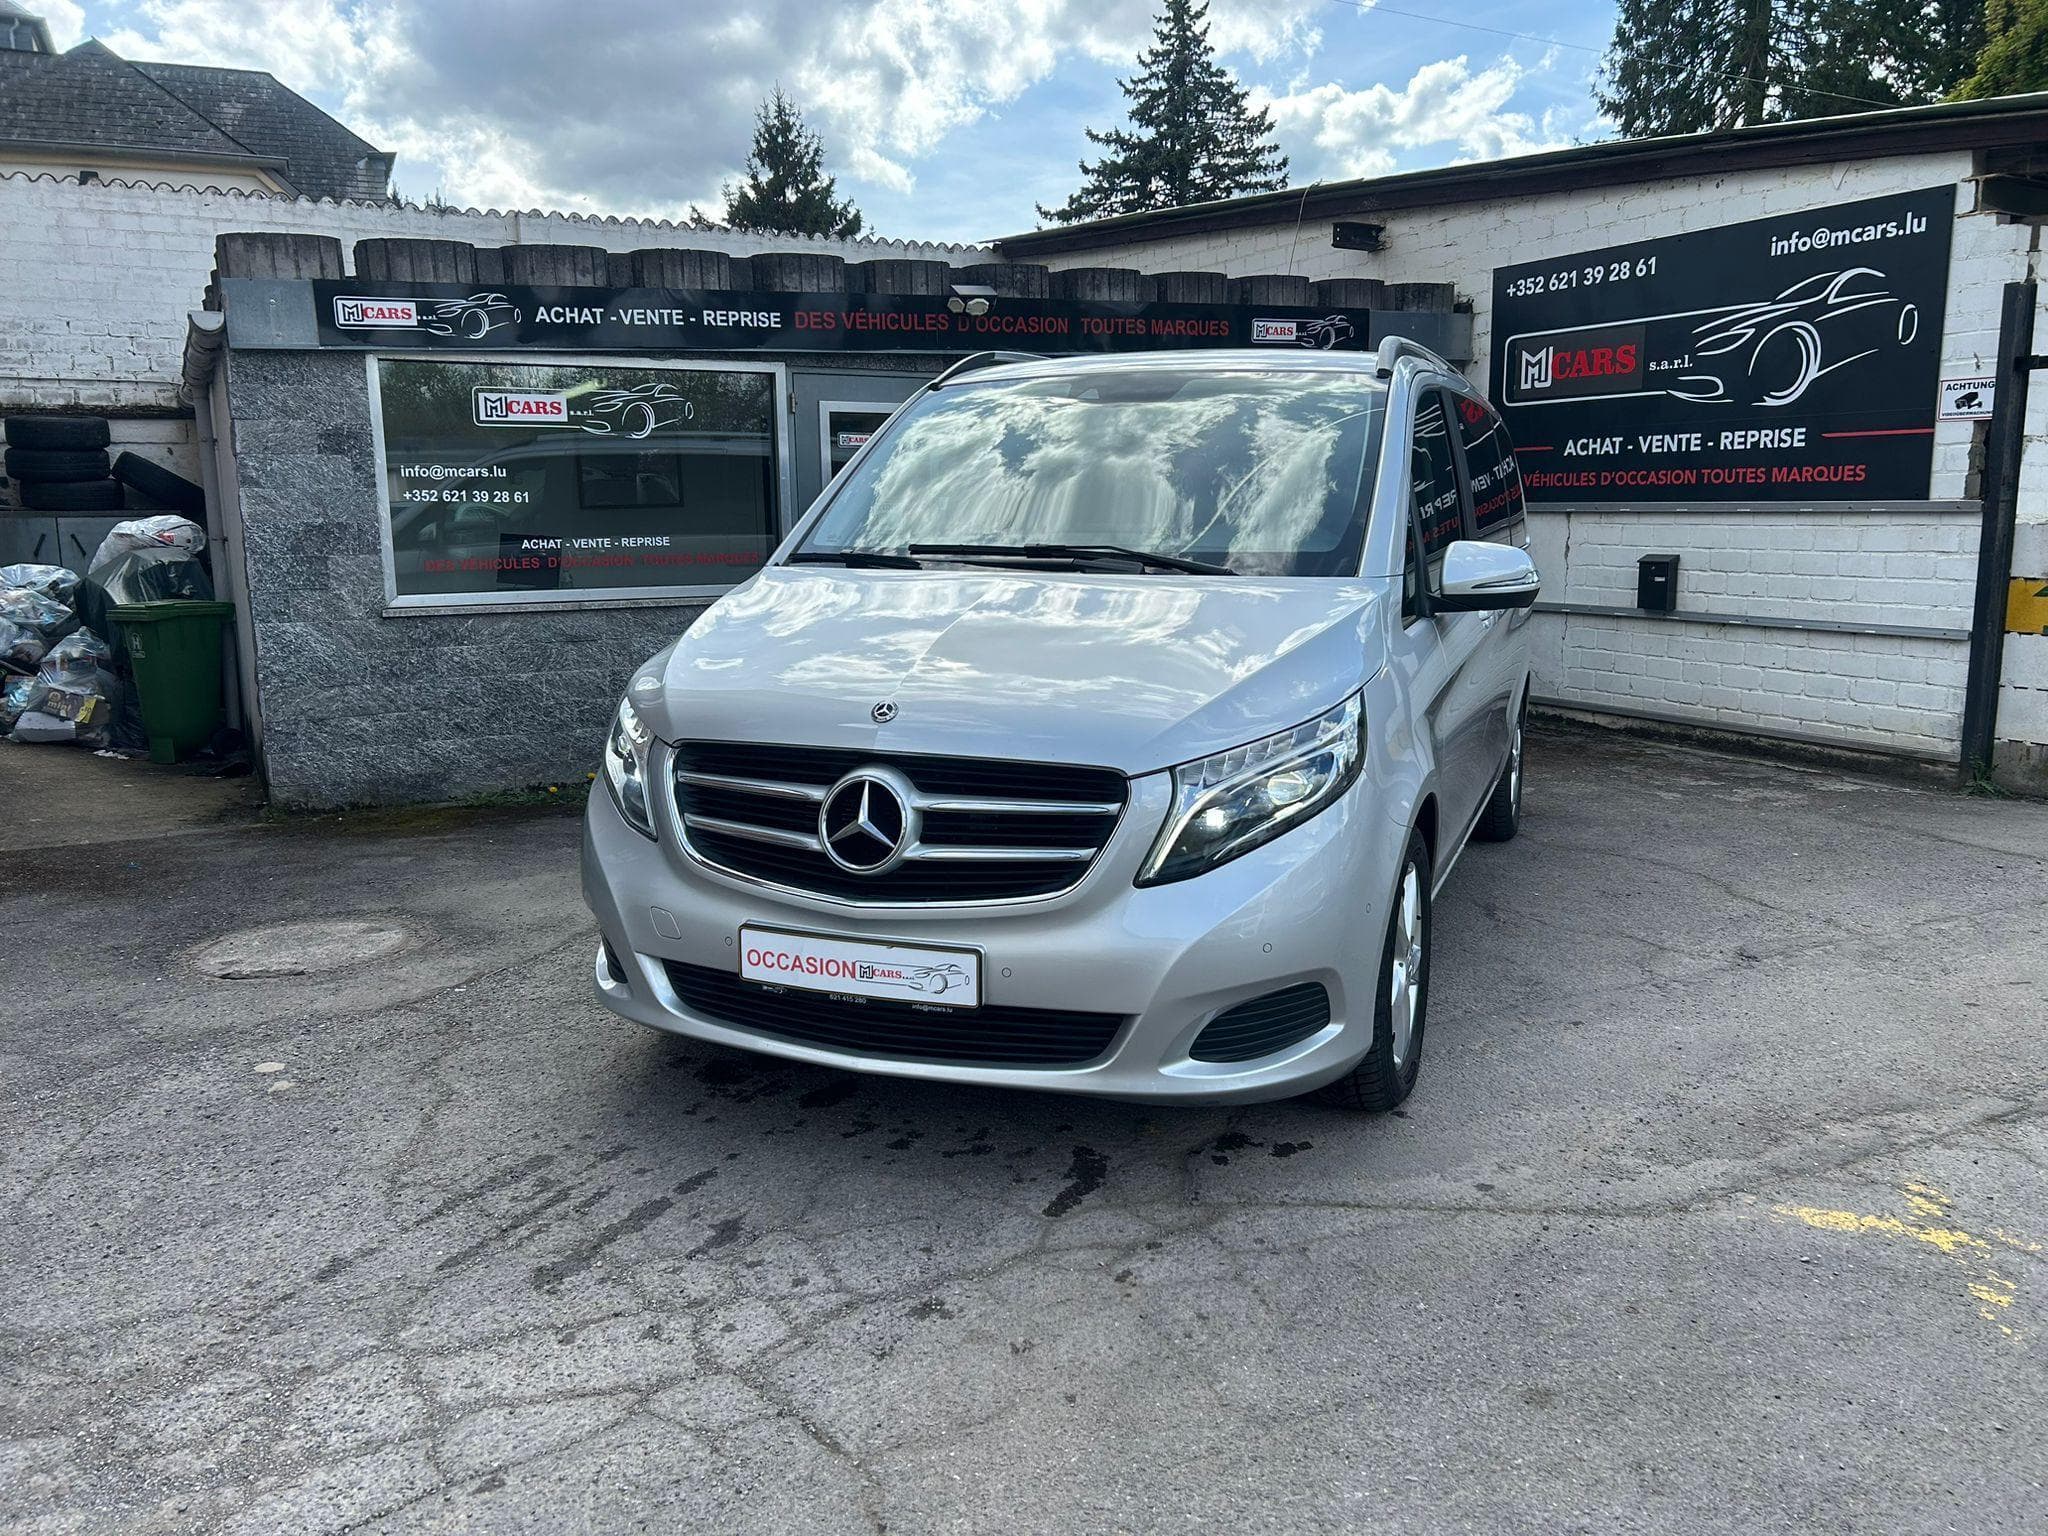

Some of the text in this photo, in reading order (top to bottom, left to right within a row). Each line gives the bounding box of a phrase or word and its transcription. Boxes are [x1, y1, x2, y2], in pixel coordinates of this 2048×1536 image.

[1770, 212, 1927, 256] info@mcars.lu
[1507, 256, 1656, 297] +352 621 39 28 61
[535, 306, 604, 324] ACHAT
[703, 310, 782, 327] REPRISE
[794, 311, 836, 329] DES
[842, 308, 949, 331] VÉHICULES
[1081, 317, 1146, 335] TOUTES
[1151, 319, 1230, 336] MARQUES
[1649, 355, 1693, 371] s.a.r.l.
[1945, 381, 1996, 392] ACHTUNG
[1564, 437, 1623, 456] ACHAT
[1638, 433, 1702, 453] VENTE
[1720, 428, 1807, 450] REPRISE
[400, 465, 507, 480] info@mcars.lu
[1523, 464, 1867, 487] VÉHICULES D'OCCASION TOUTES MARQUES
[403, 489, 530, 503] +352 621 39 28 61
[521, 539, 563, 549] ACHAT
[572, 538, 611, 548] VENTE
[621, 536, 670, 547] REPRISE
[747, 949, 857, 979] OCCASION
